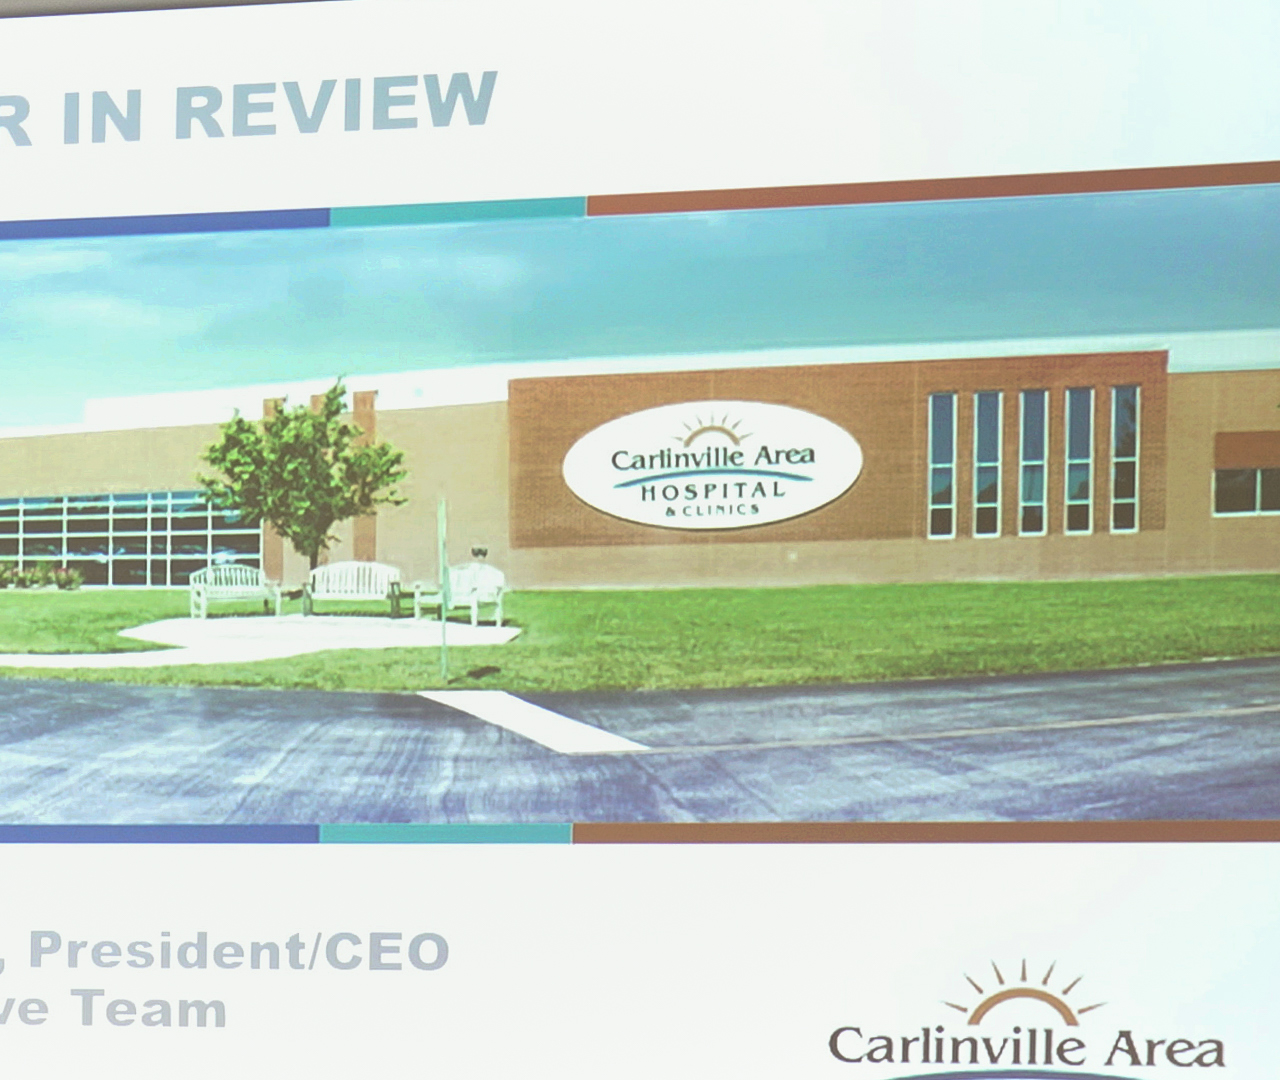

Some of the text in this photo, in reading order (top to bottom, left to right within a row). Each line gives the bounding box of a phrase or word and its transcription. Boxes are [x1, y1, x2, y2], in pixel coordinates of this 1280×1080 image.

[64, 89, 141, 145] IN
[176, 70, 498, 140] REVIEW
[611, 445, 816, 471] Carlinville Area
[642, 481, 786, 501] HOSPITAL
[30, 930, 450, 971] President/CEO
[70, 989, 227, 1028] Team
[829, 1026, 1226, 1067] Carlinville Area
